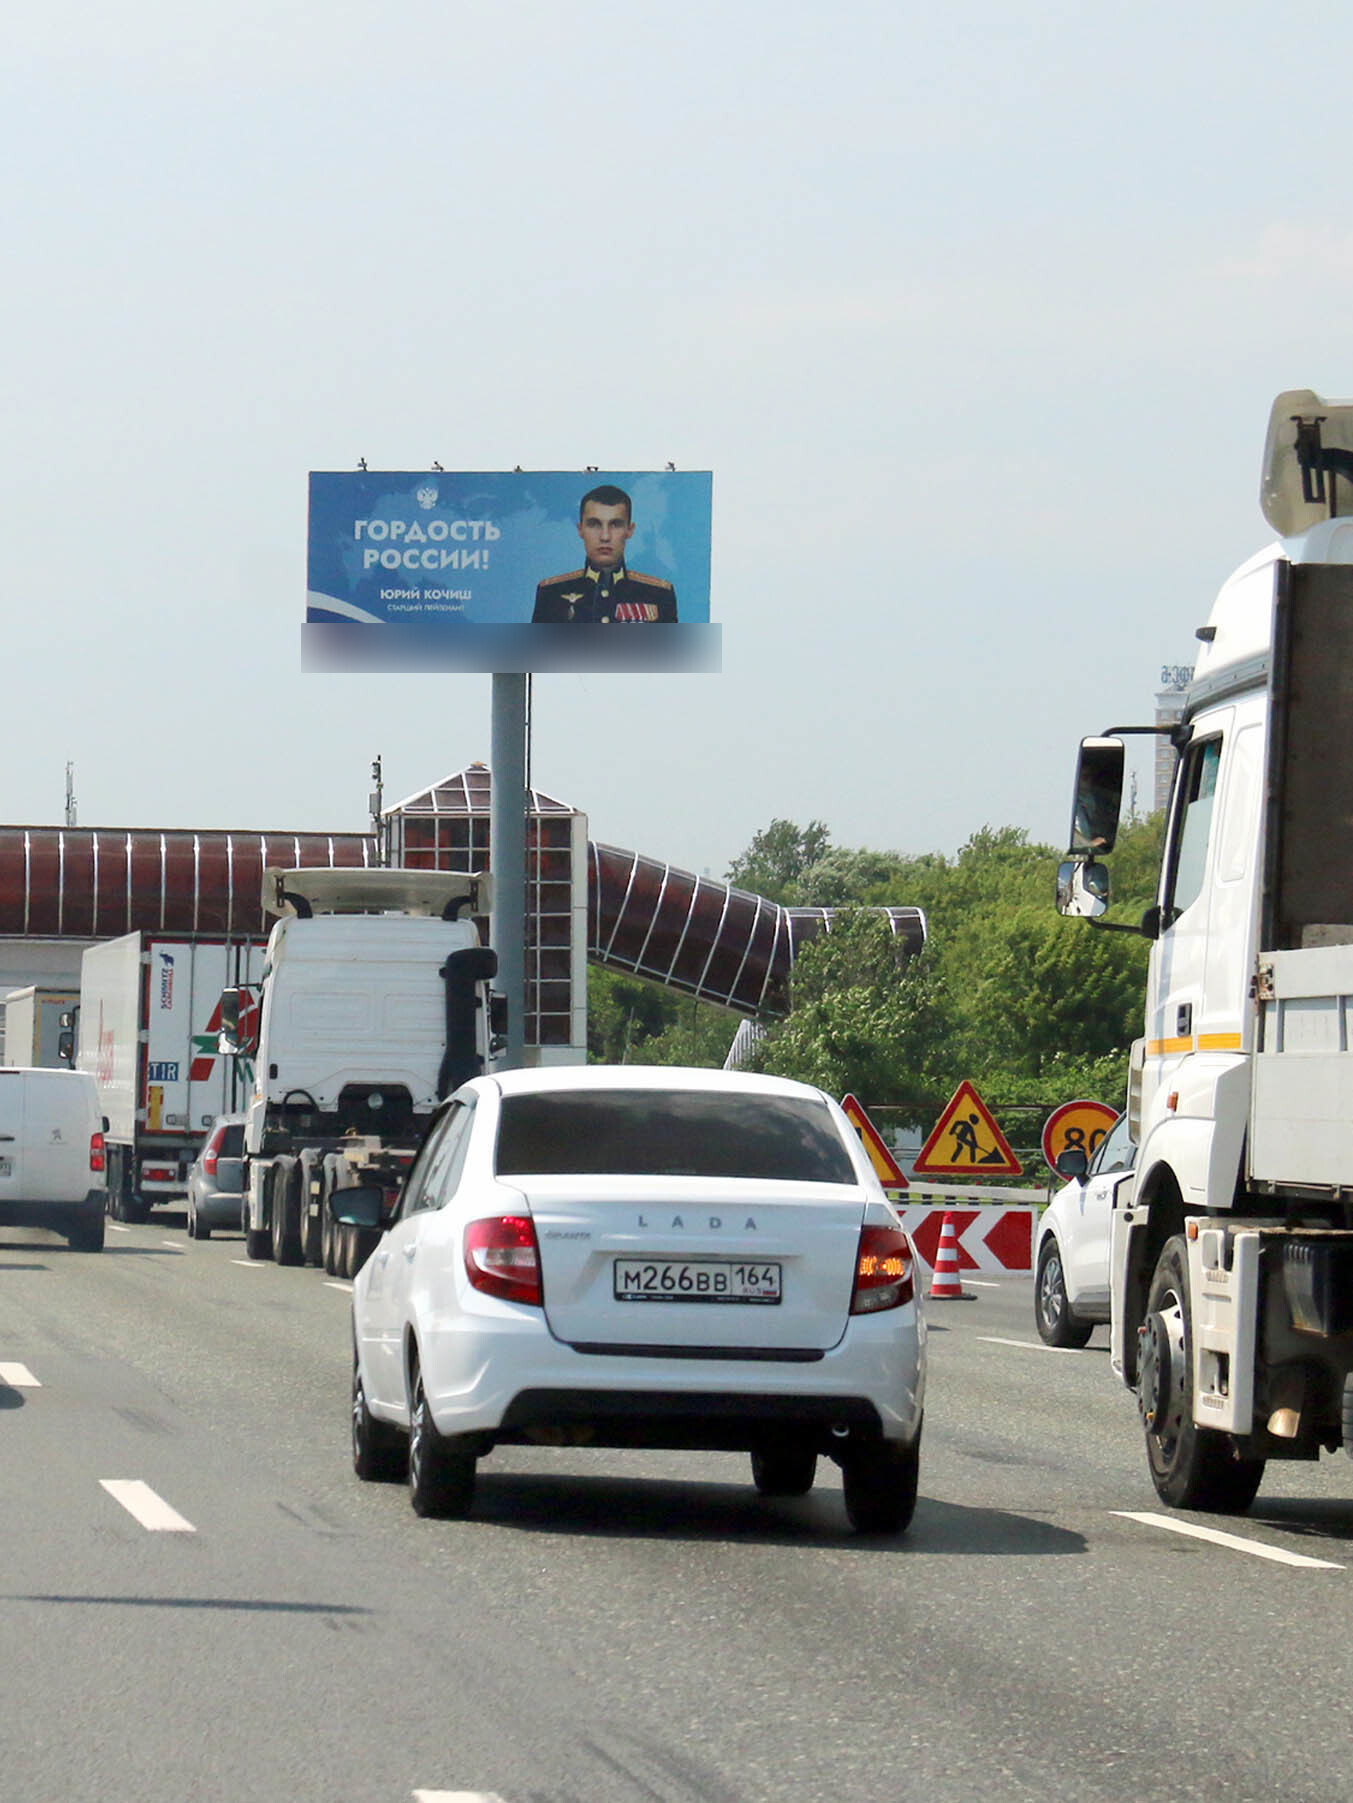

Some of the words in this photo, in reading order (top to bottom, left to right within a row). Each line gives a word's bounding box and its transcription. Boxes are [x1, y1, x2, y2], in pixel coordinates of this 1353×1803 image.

[354, 520, 501, 543] ГОРДОСТЬ
[363, 549, 489, 570] РОССИИ!
[380, 586, 420, 600] ЮРИЙ
[424, 589, 472, 600] КОЧИШ
[151, 1063, 178, 1080] TIR
[638, 1215, 757, 1230] LADA
[624, 1265, 727, 1293] М266ВВ
[735, 1267, 774, 1287] 164
